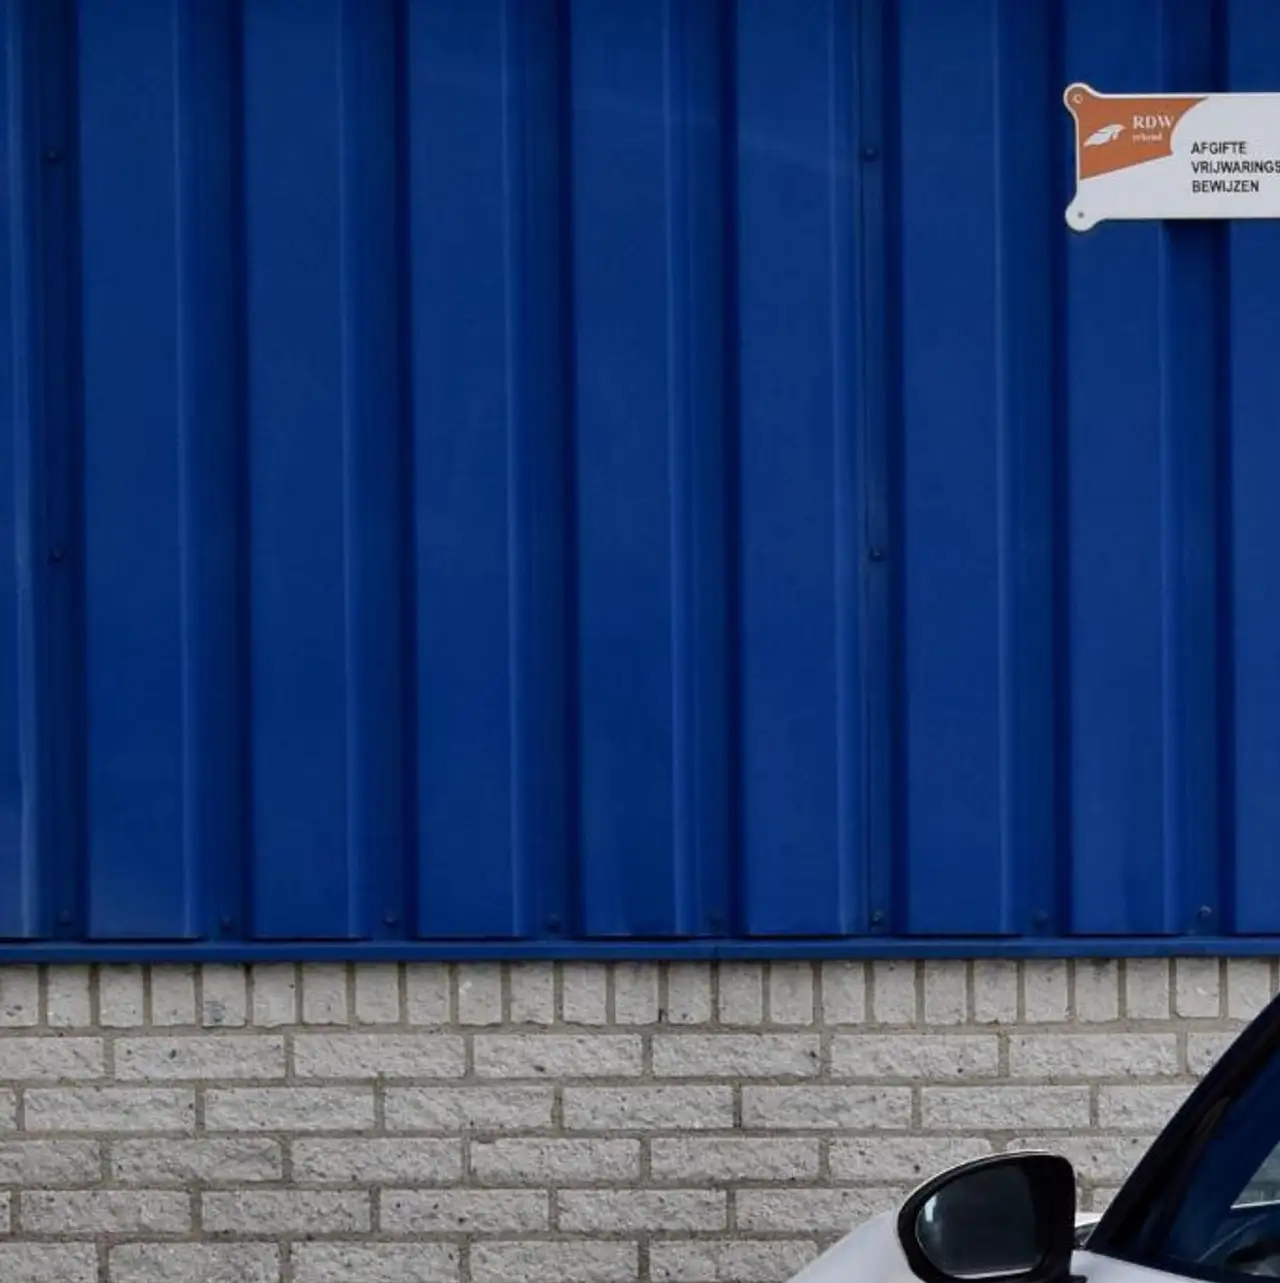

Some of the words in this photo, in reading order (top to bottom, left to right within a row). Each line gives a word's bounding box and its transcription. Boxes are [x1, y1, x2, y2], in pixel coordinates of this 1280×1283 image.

[1132, 115, 1174, 129] RDW
[1191, 141, 1247, 154] AFGIFTE
[1192, 180, 1260, 193] BEWIJZEN
